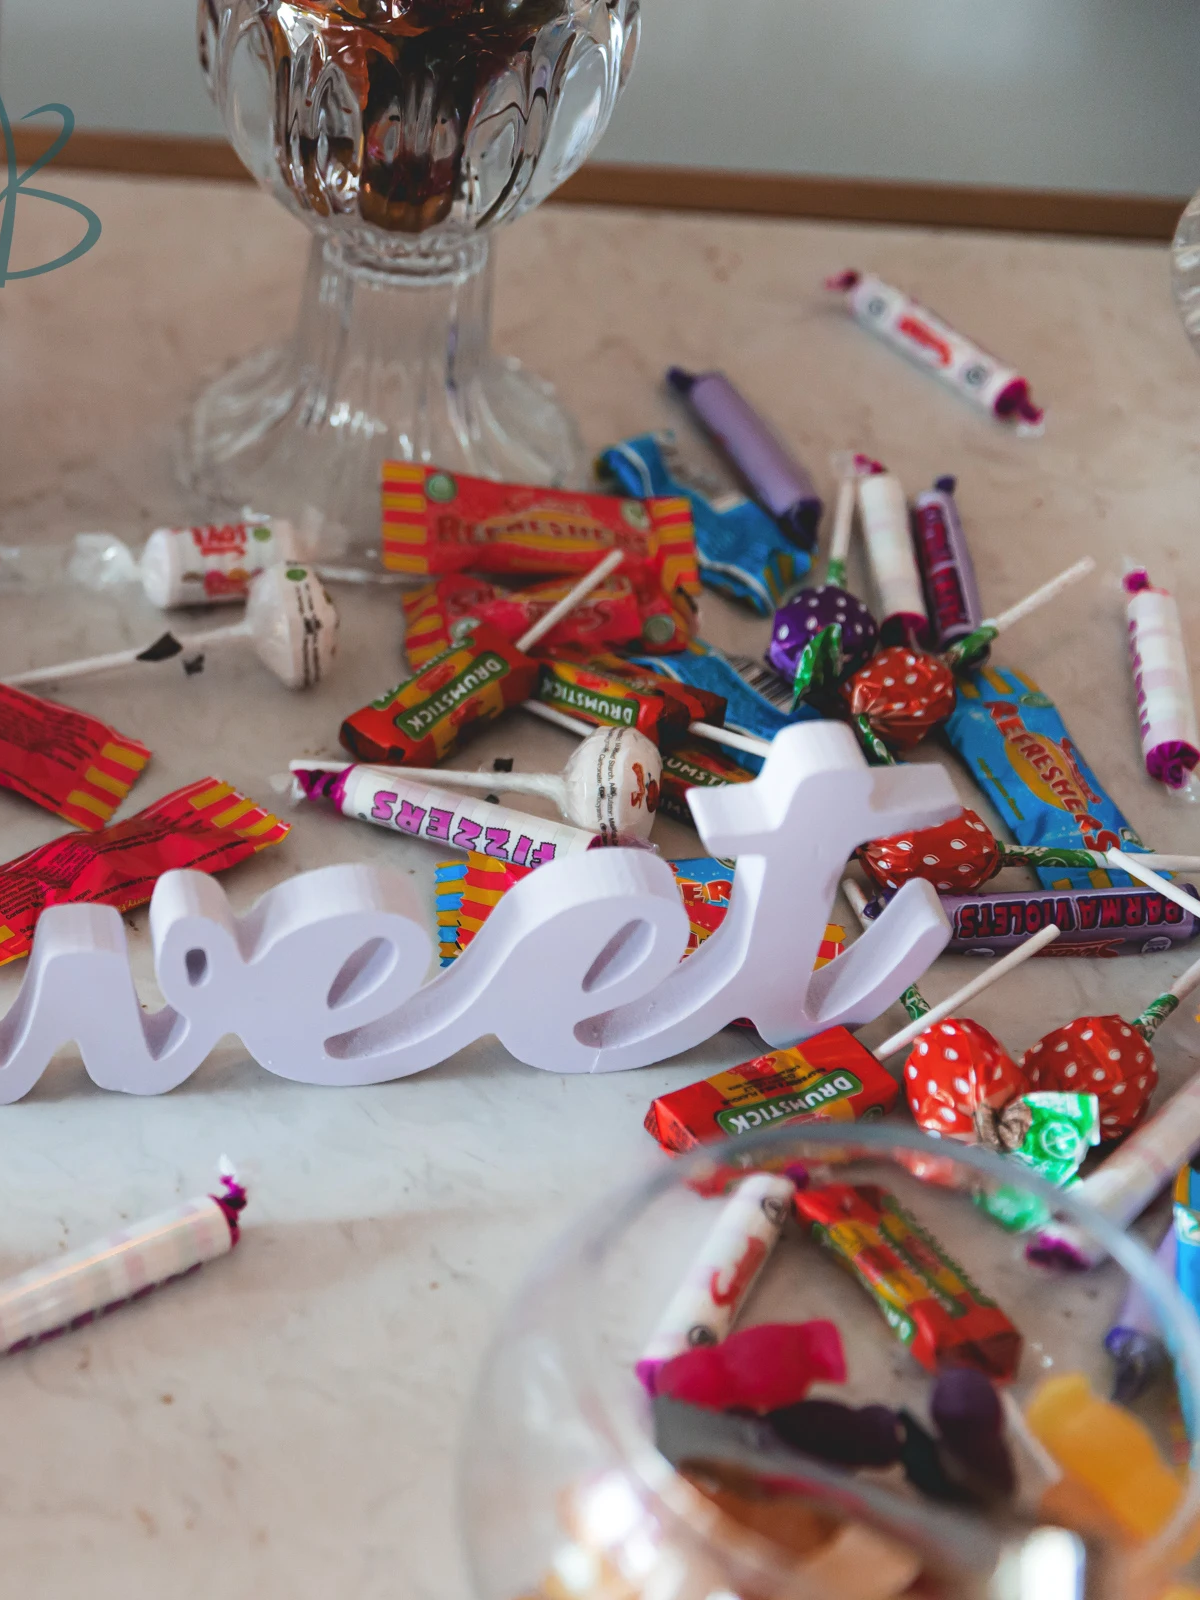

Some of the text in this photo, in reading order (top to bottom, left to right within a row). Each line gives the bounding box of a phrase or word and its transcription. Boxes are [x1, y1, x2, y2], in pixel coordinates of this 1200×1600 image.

[406, 655, 504, 731] DRUMSTICK
[985, 702, 1121, 853] REFRESHERS
[371, 790, 557, 868] FIZZERS
[960, 888, 1185, 940] PARMA VIOLETS
[728, 1076, 854, 1135] DRUMSTICK
